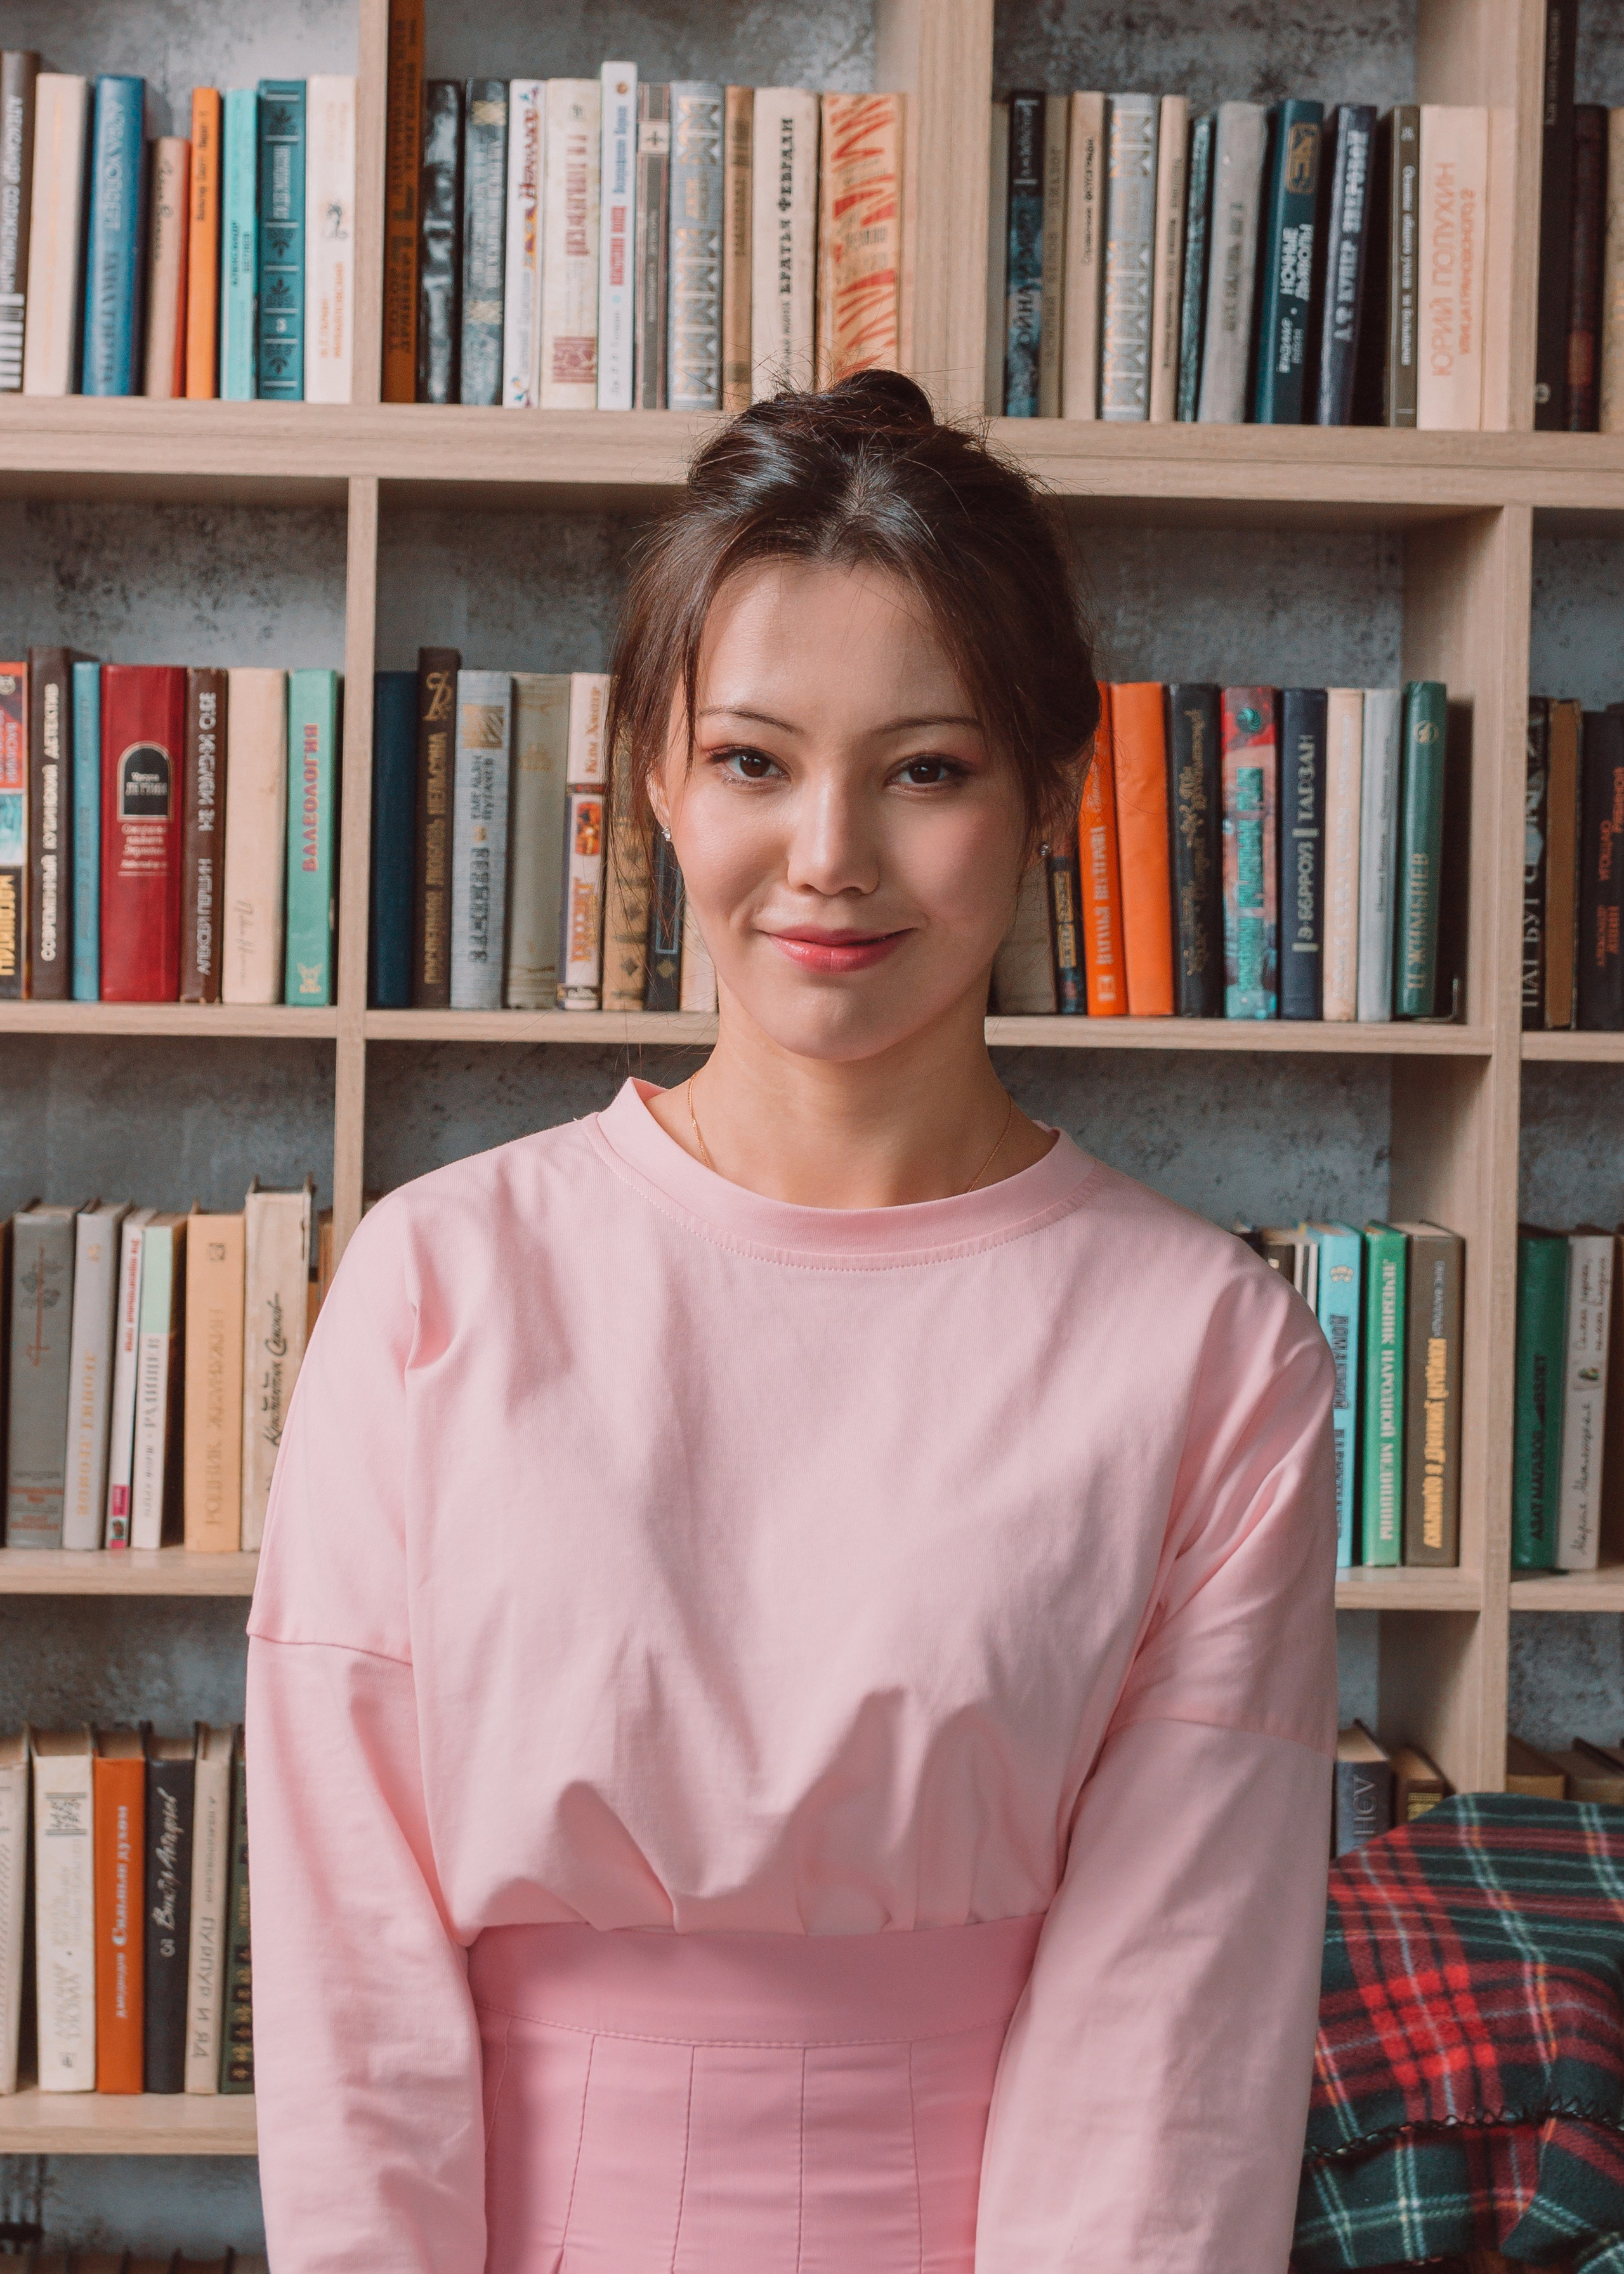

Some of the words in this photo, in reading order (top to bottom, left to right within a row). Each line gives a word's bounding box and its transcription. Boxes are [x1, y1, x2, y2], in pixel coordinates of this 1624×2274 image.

[778, 218, 793, 295] БРАТЬЯ
[1281, 227, 1300, 294] НОЧНЫЕ
[1431, 161, 1457, 288] ПОЛУХИН
[1429, 296, 1455, 378] ЮРИЙ
[44, 683, 60, 759] ДЕТЕКТИВ
[302, 723, 320, 873] ВАЛЕОЛОГИЯ
[1295, 733, 1316, 821] ТАРЗАН
[41, 854, 58, 962] СОВРЕМЕННЫЙ
[1380, 1258, 1398, 1344] ЛЕЧЕБНИК
[1379, 1349, 1398, 1438] НАРОДНОЙ
[1378, 1442, 1396, 1541] МЕДИЦИНЫ
[159, 1938, 176, 1957] 3
[197, 1916, 216, 1997] ПУРПУР
[193, 2032, 213, 2060] ЯД
[196, 2006, 213, 2021] И
